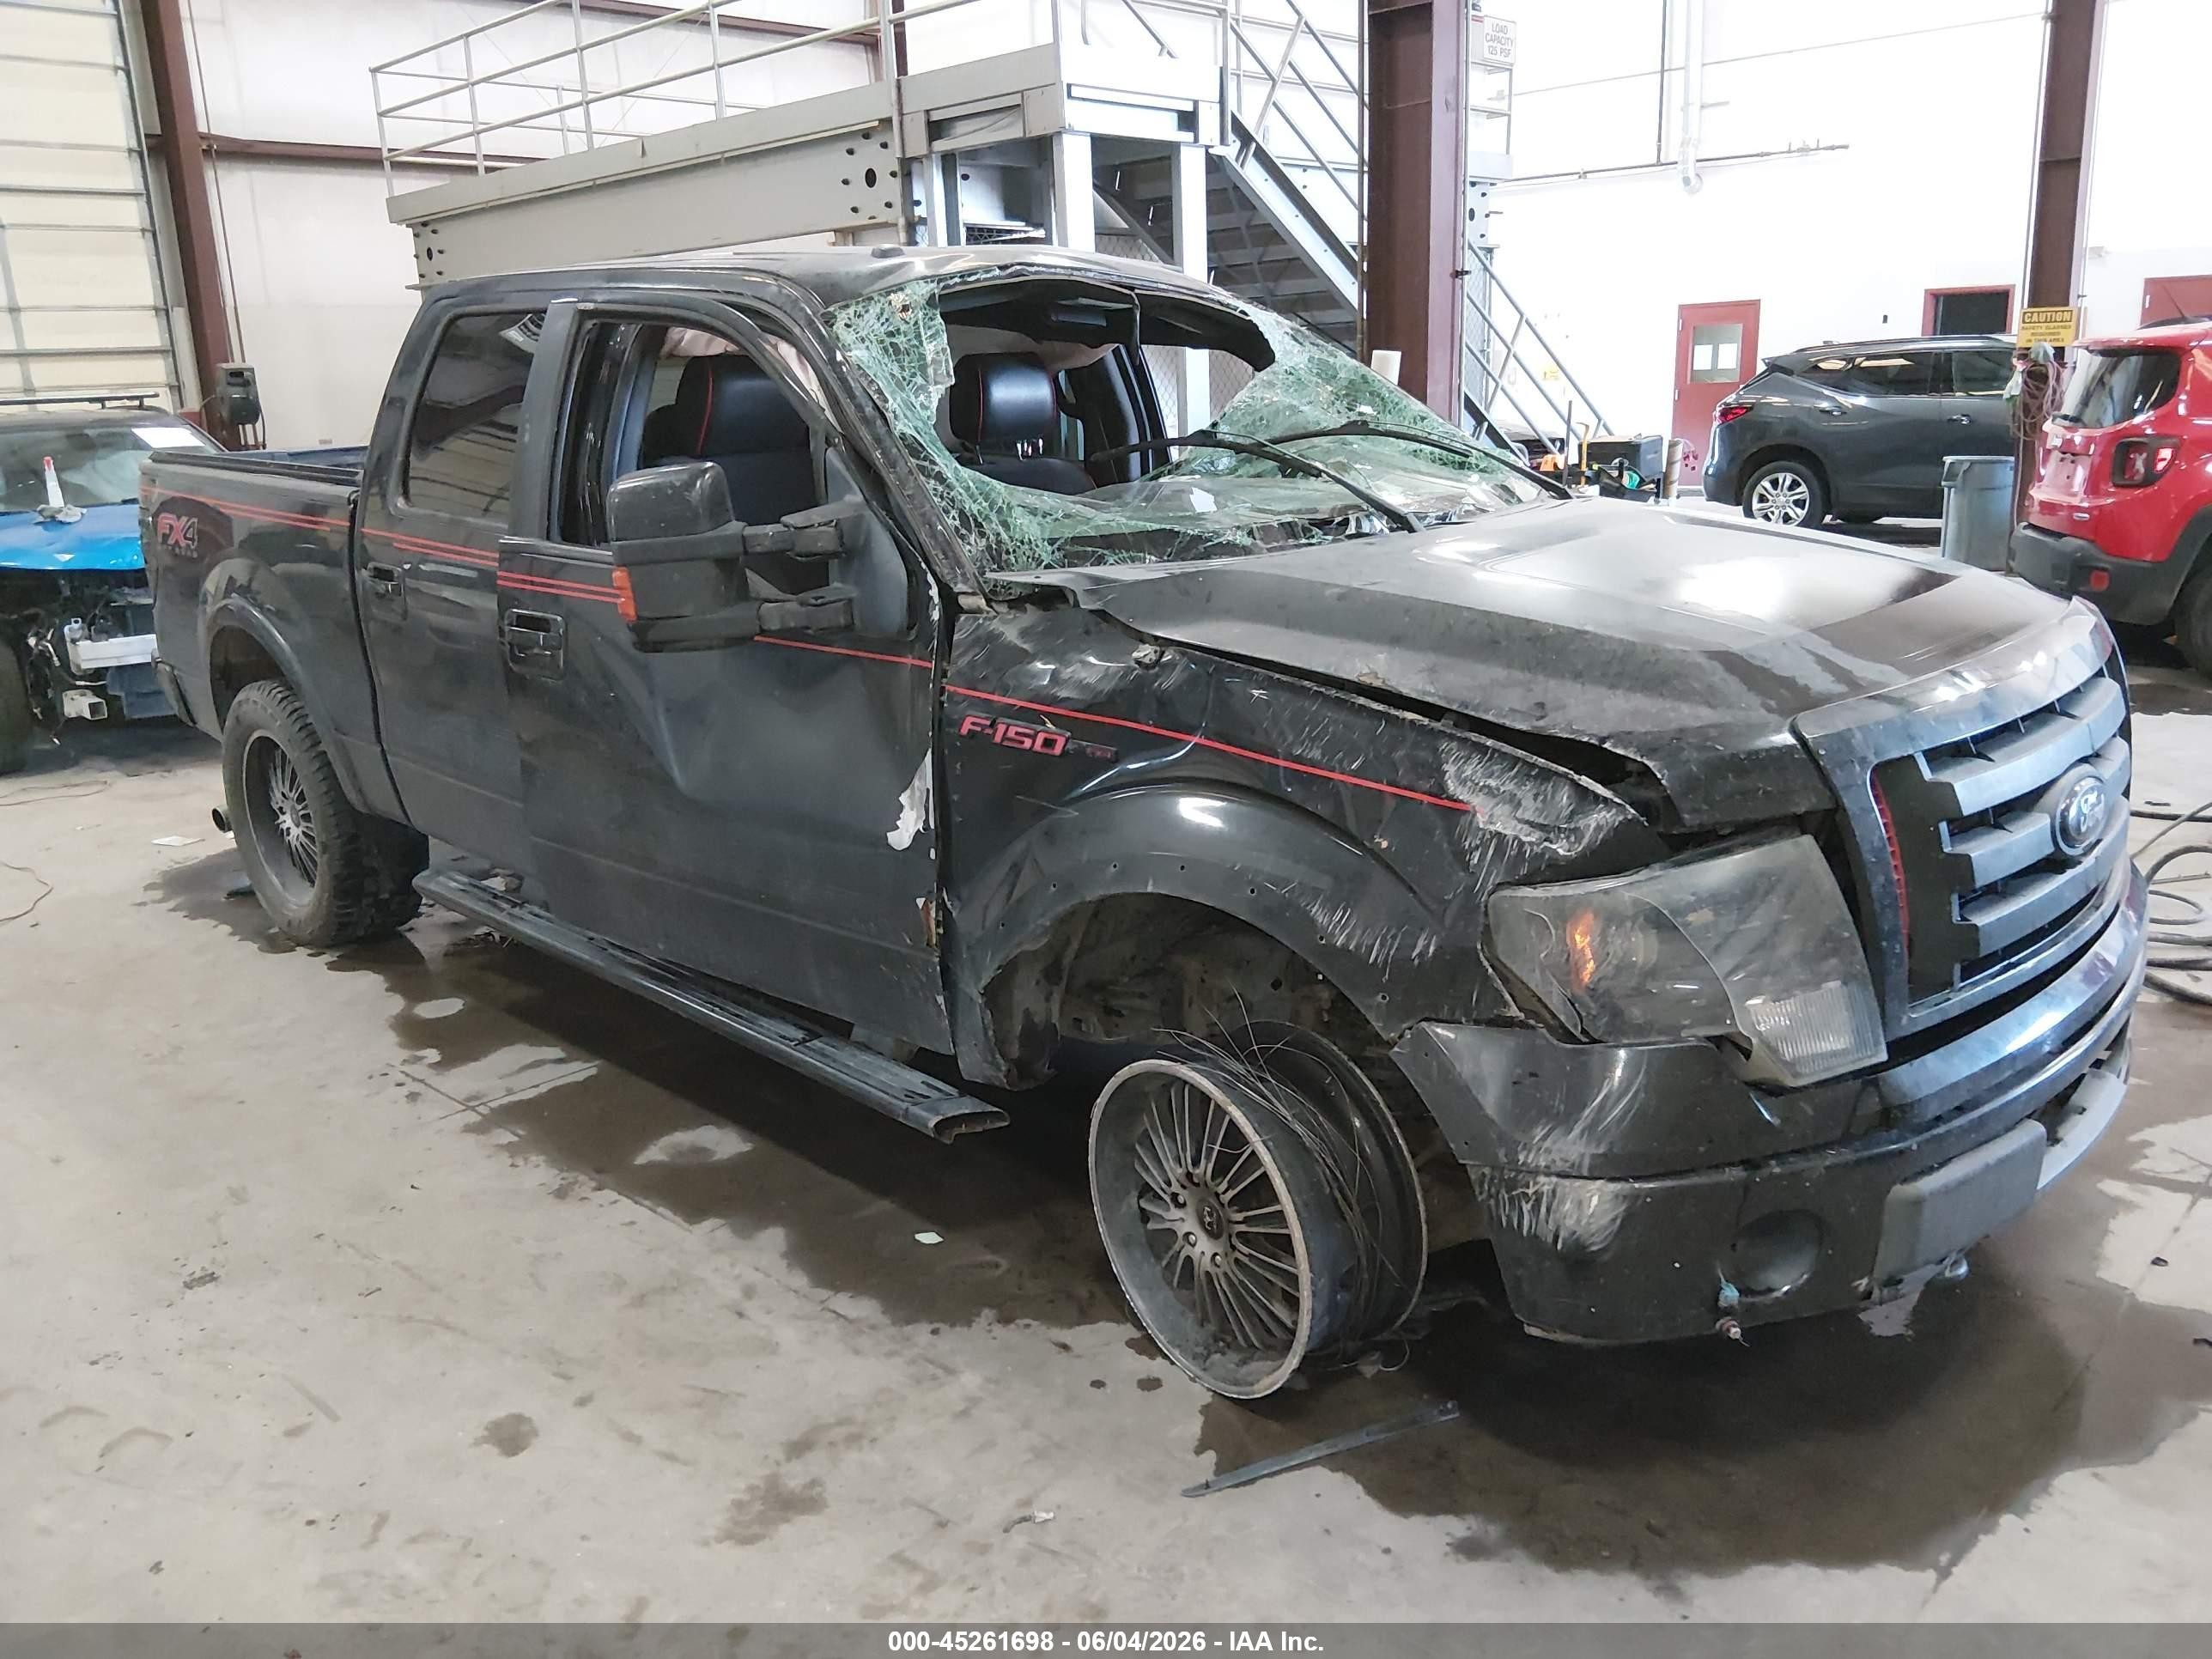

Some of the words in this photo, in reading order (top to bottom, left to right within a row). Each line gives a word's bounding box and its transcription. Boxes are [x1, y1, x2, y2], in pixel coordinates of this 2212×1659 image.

[1492, 22, 1509, 35] LOAD
[1485, 33, 1514, 47] CAPACITY
[1487, 46, 1498, 56] 125
[1499, 47, 1512, 58] PSF
[2024, 311, 2071, 323] CAUTION
[157, 512, 198, 549] FX4
[959, 716, 1067, 757] F-150
